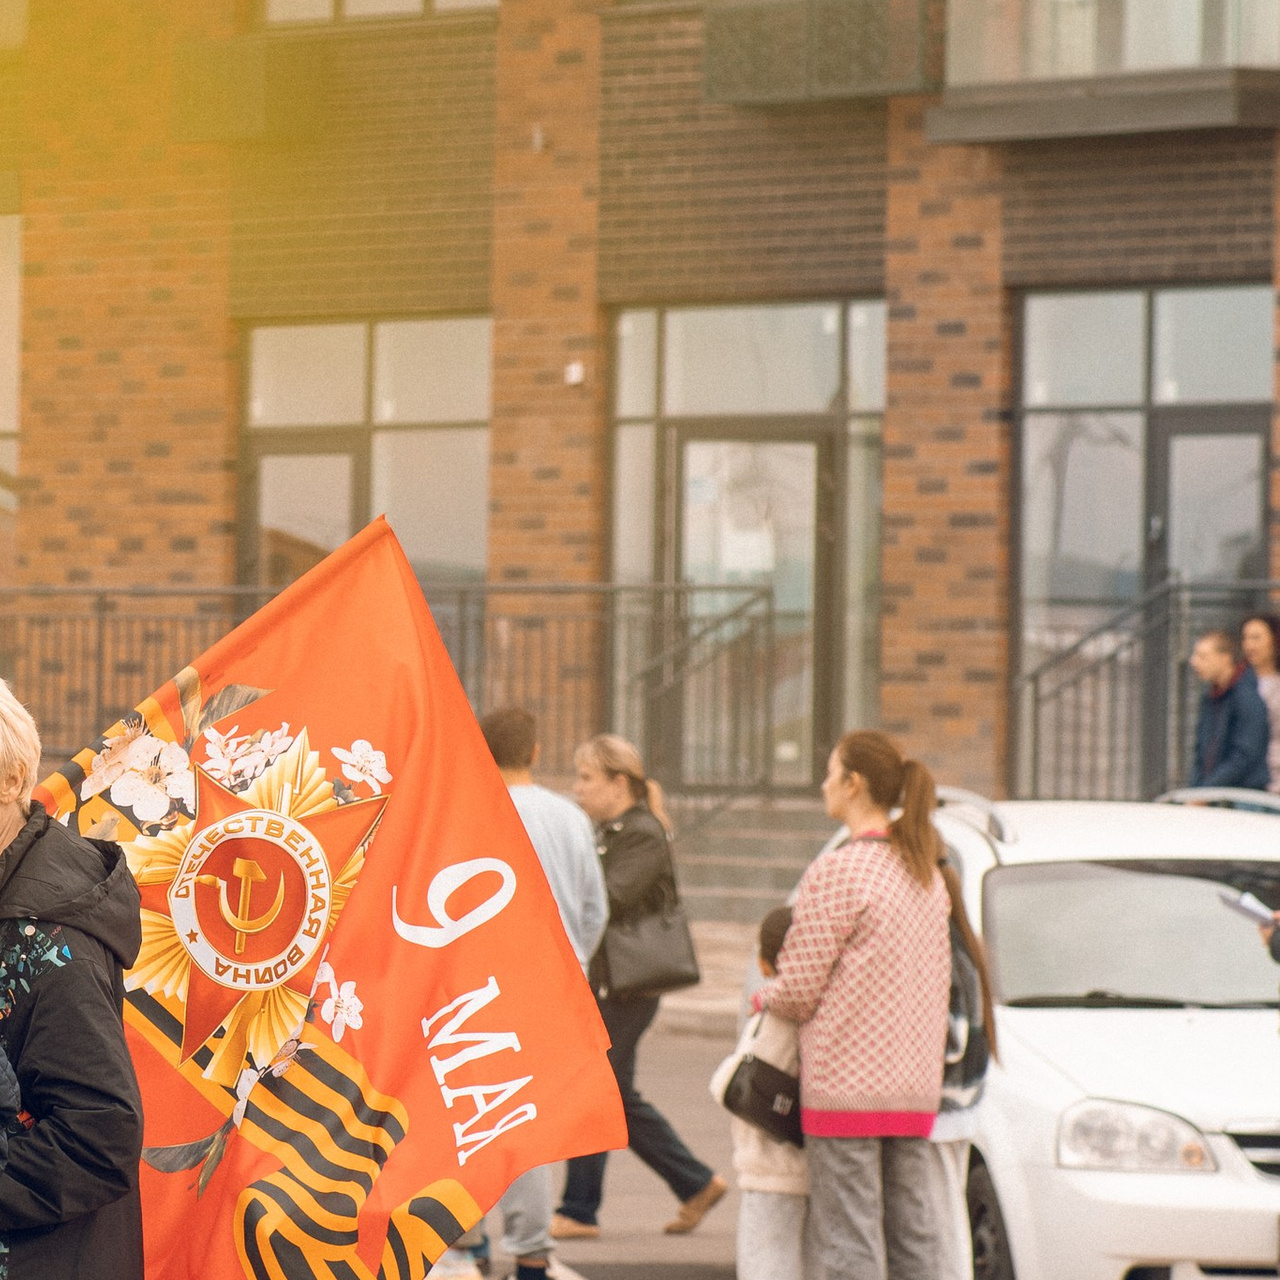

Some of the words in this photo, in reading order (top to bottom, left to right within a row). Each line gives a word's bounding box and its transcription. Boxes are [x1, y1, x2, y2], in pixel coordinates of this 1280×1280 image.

[174, 816, 327, 939] ОТЕЧЕСТВЕННАЯ
[392, 857, 517, 948] 9
[214, 944, 305, 985] ВОЙНА
[421, 975, 537, 1166] МАЯ
